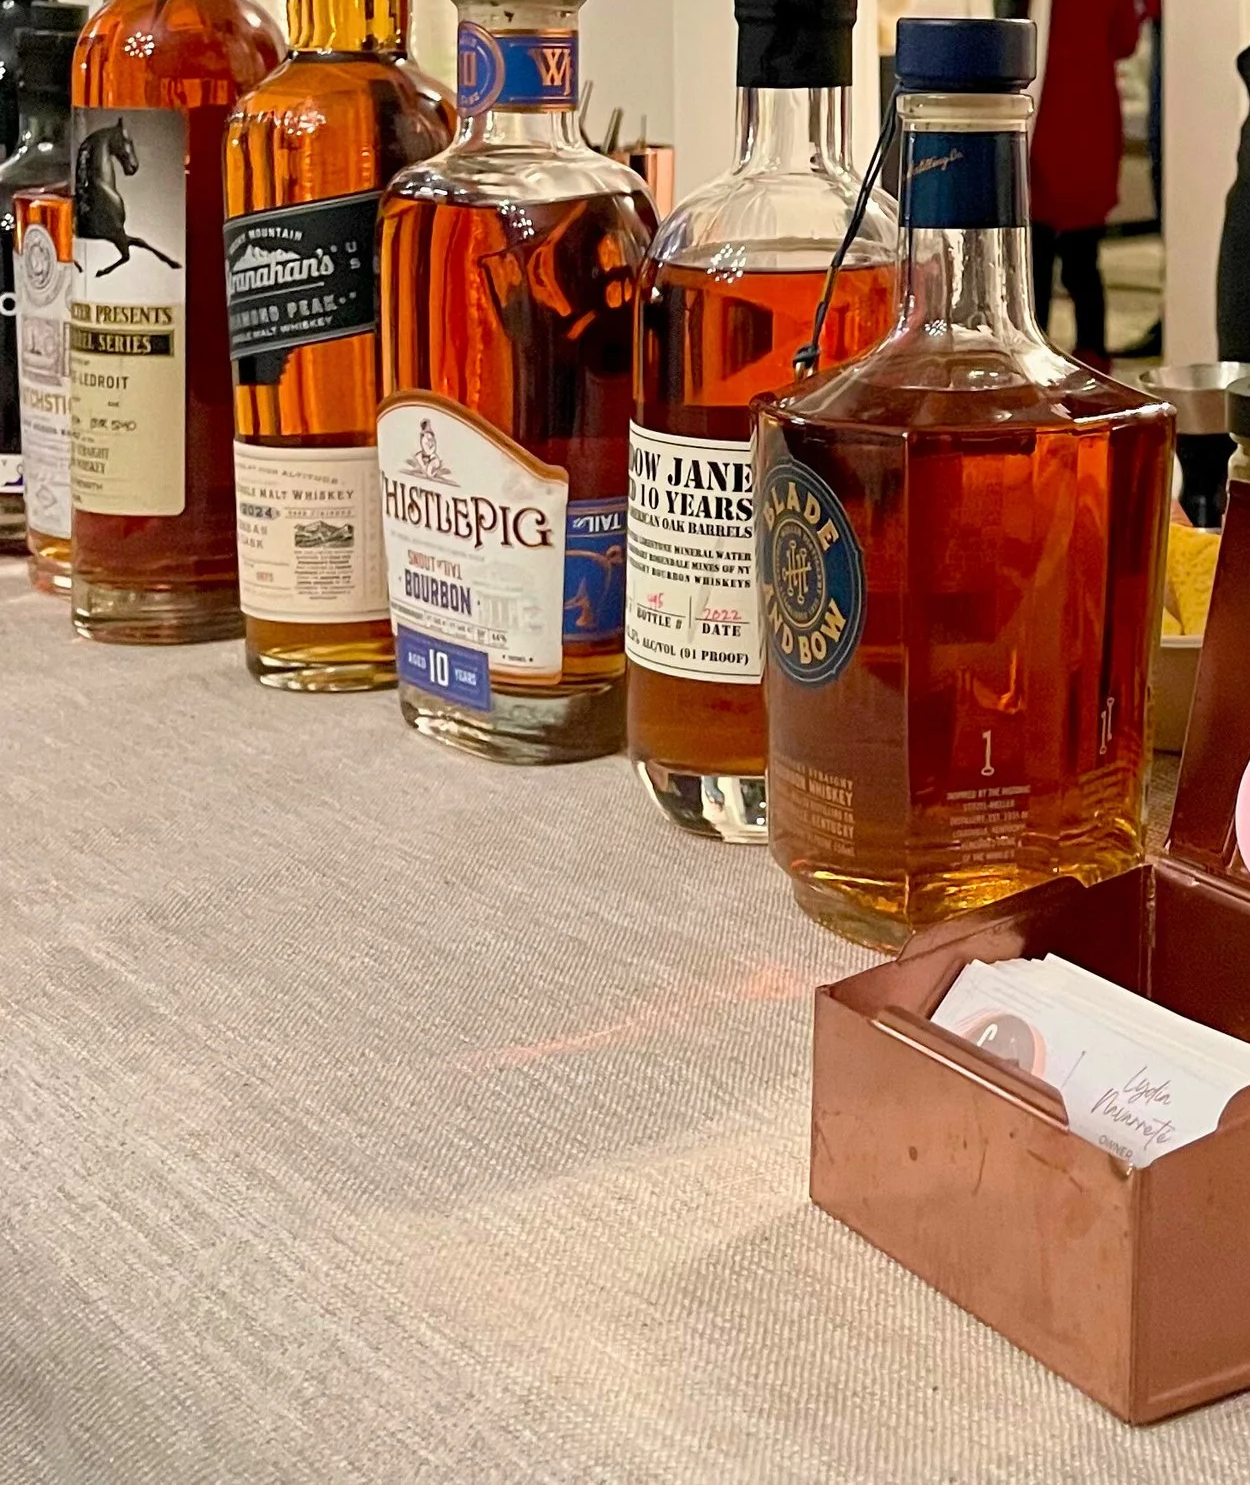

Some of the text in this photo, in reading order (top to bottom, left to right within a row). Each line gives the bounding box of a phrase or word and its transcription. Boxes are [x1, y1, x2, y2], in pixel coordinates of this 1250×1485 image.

[249, 226, 303, 242] MOUNTAIN
[229, 247, 335, 295] ranahan's
[95, 304, 173, 326] PRESENTS
[287, 293, 337, 319] PEAK
[280, 315, 334, 333] WHISKEY
[99, 333, 152, 354] SERIES
[667, 456, 753, 493] JANE
[260, 488, 288, 501] MALT
[292, 489, 355, 502] WHISKEY
[641, 483, 660, 510] 10
[666, 490, 754, 522] YEARS
[381, 471, 556, 550] HISTLEPIG
[763, 481, 840, 551] BLADE
[662, 517, 685, 533] OAK
[688, 521, 753, 539] BARRELS
[674, 545, 714, 558] MINERAL
[716, 548, 752, 561] WATER
[694, 575, 752, 589] WHISKEYS
[737, 565, 752, 575] NY
[404, 568, 473, 617] BOURBON
[636, 606, 672, 629] BOTTLE
[702, 622, 742, 637] DATE
[797, 598, 848, 665] BOW
[408, 648, 478, 687] AGED 10 YEARS
[680, 647, 697, 660] (91
[702, 650, 749, 666] PROOF)
[1122, 1064, 1172, 1106] Lydia
[1098, 1134, 1134, 1160] OWNER
